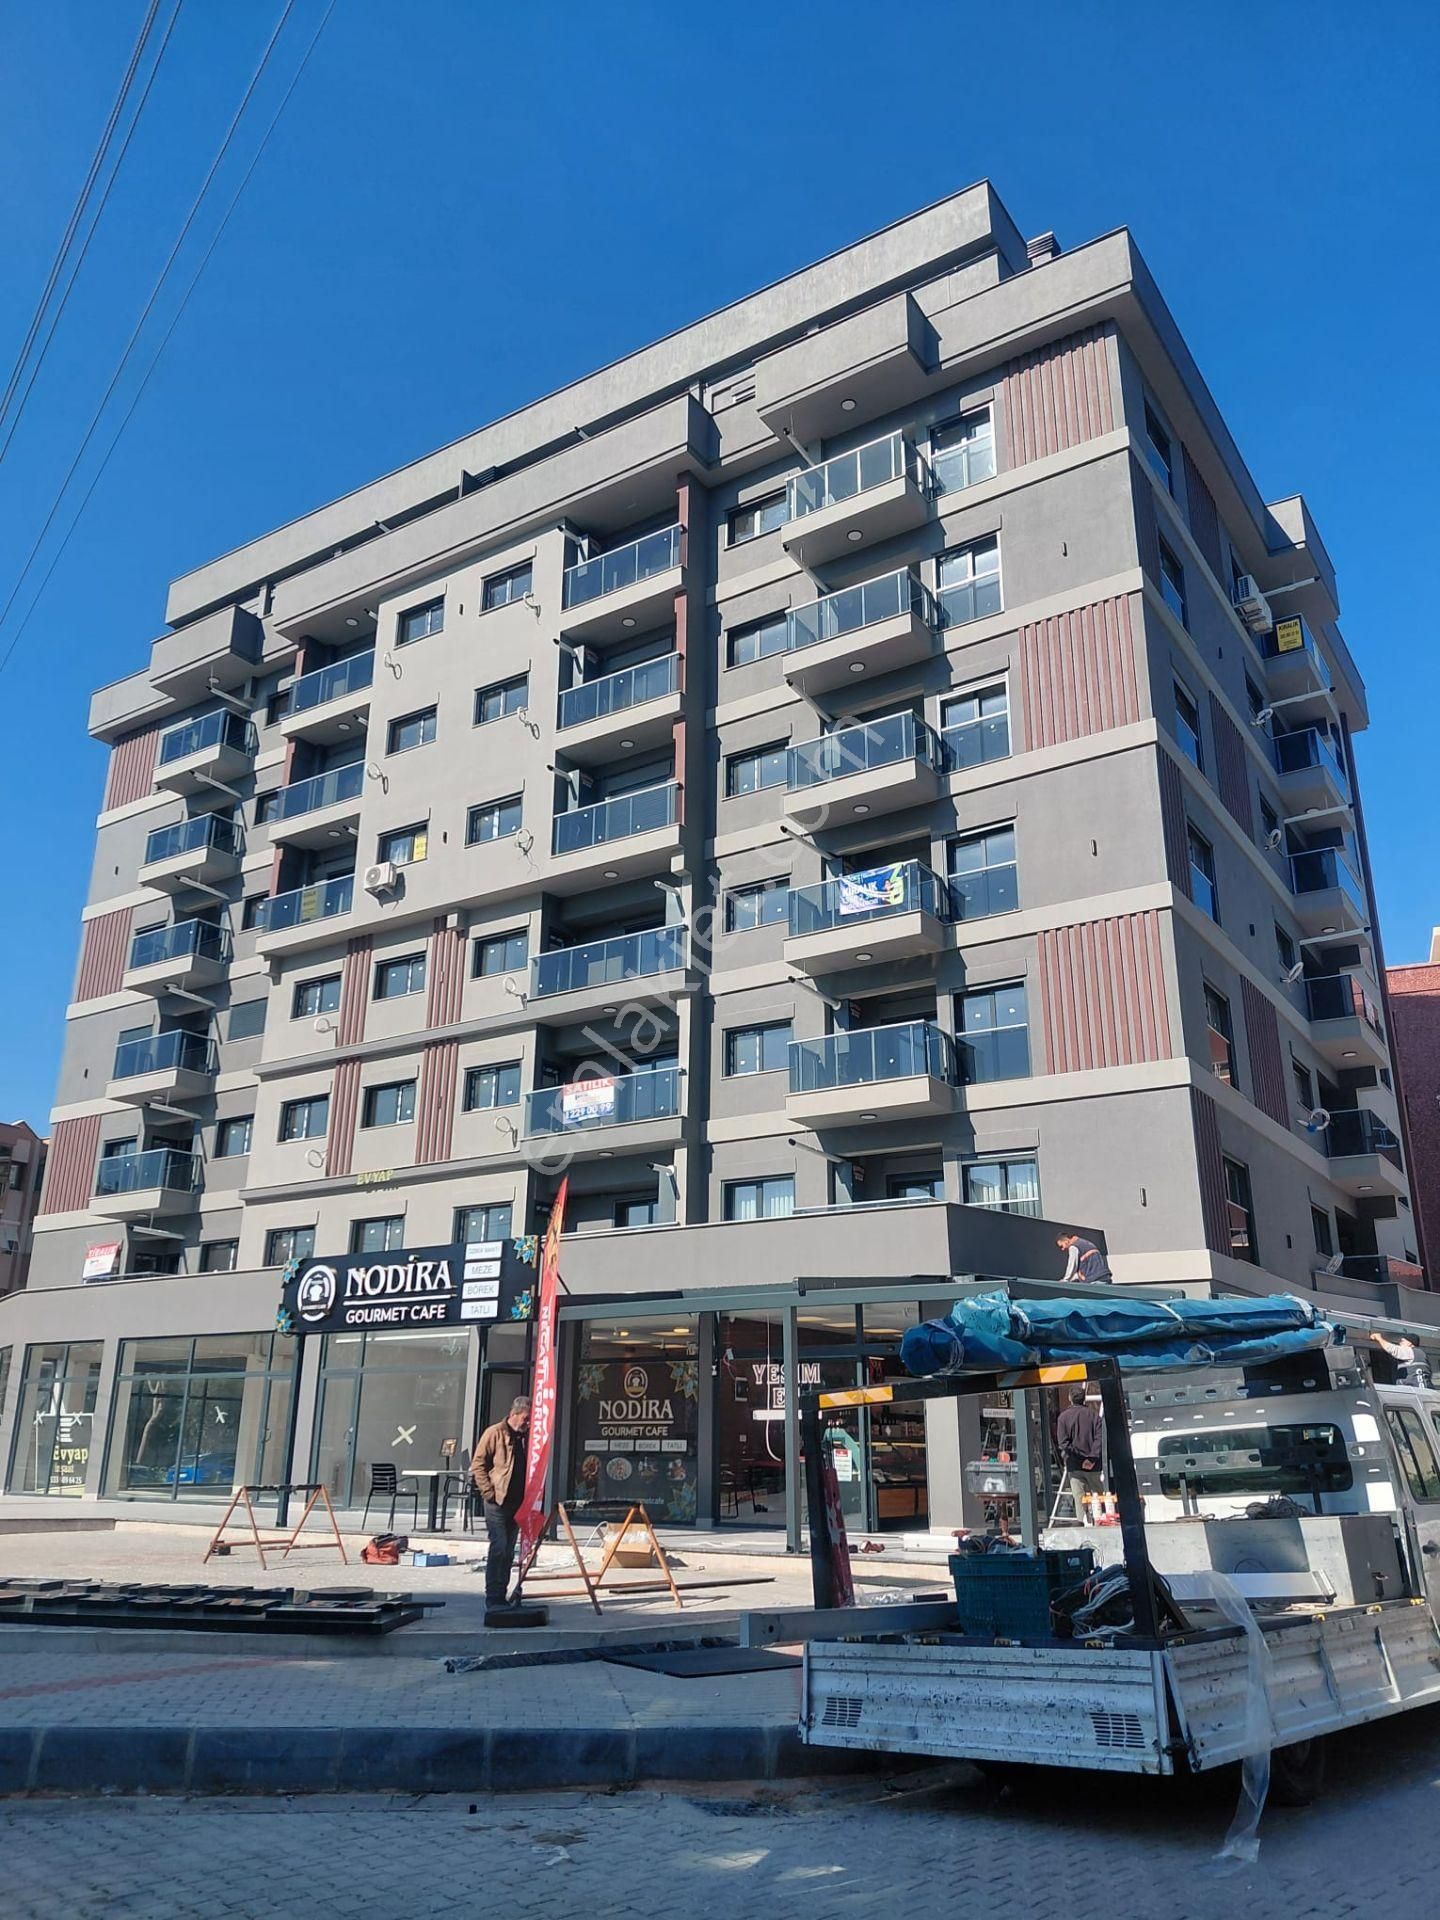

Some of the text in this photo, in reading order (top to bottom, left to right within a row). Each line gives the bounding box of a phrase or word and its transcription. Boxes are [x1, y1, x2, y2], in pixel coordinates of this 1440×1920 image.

[357, 1169, 394, 1185] EVYAP
[471, 1264, 494, 1275] MEZE
[345, 1303, 446, 1324] GOURMET CAFE
[601, 1426, 669, 1437] GOURMET CAFE
